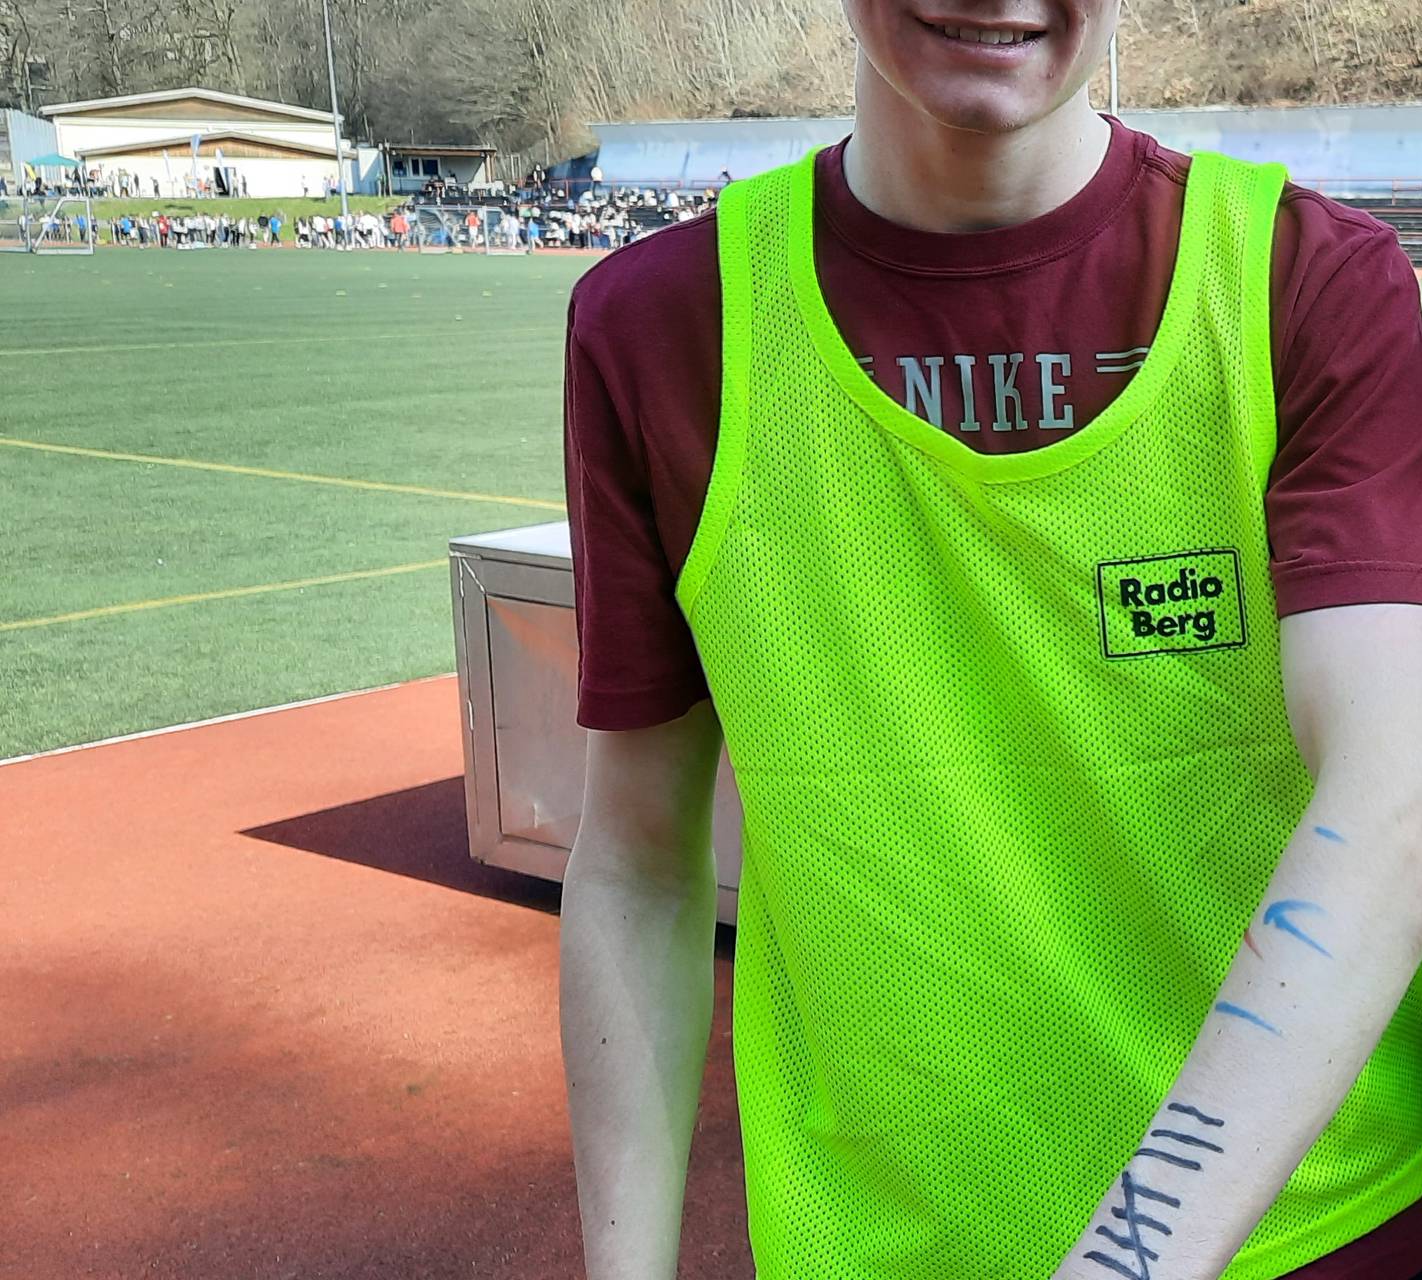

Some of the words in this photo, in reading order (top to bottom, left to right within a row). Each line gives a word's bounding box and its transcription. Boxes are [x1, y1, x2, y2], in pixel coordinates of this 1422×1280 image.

[896, 353, 1074, 431] NIKE
[1119, 567, 1223, 608] Radio
[1131, 610, 1216, 641] Berg
